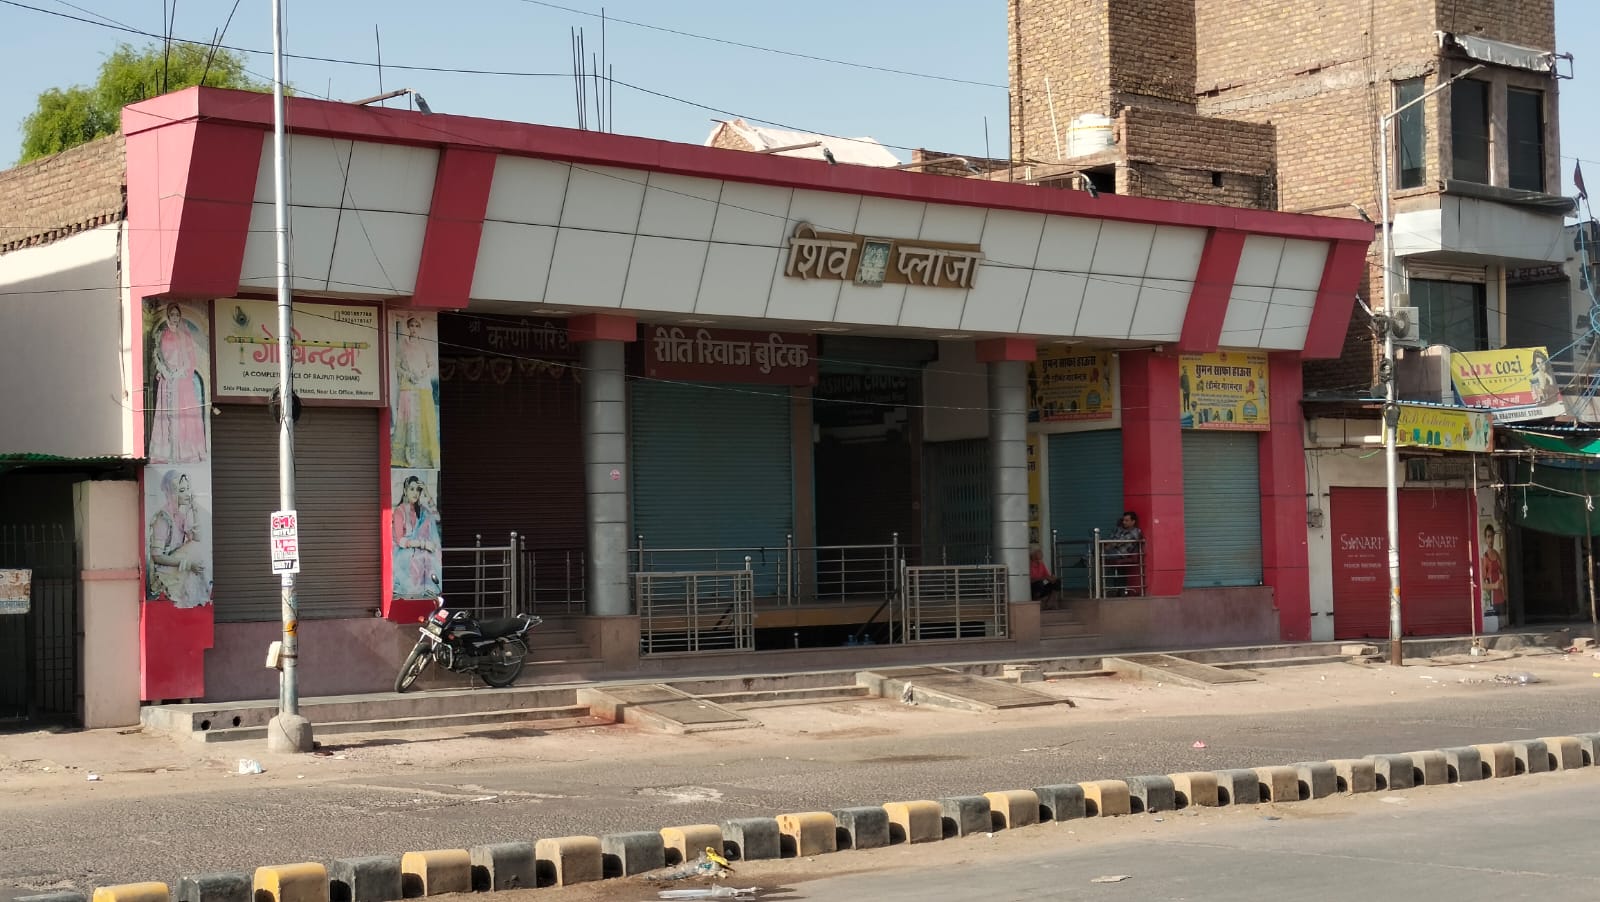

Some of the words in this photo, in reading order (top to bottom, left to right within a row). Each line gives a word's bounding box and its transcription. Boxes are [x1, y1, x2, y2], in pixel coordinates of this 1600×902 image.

[785, 222, 857, 280] शिव
[897, 244, 985, 289] प्लाजा
[653, 326, 694, 363] रीति
[696, 328, 752, 366] रिवाज
[753, 332, 809, 374] बुटिक
[1196, 363, 1213, 379] सुमन
[1460, 364, 1493, 377] LUX
